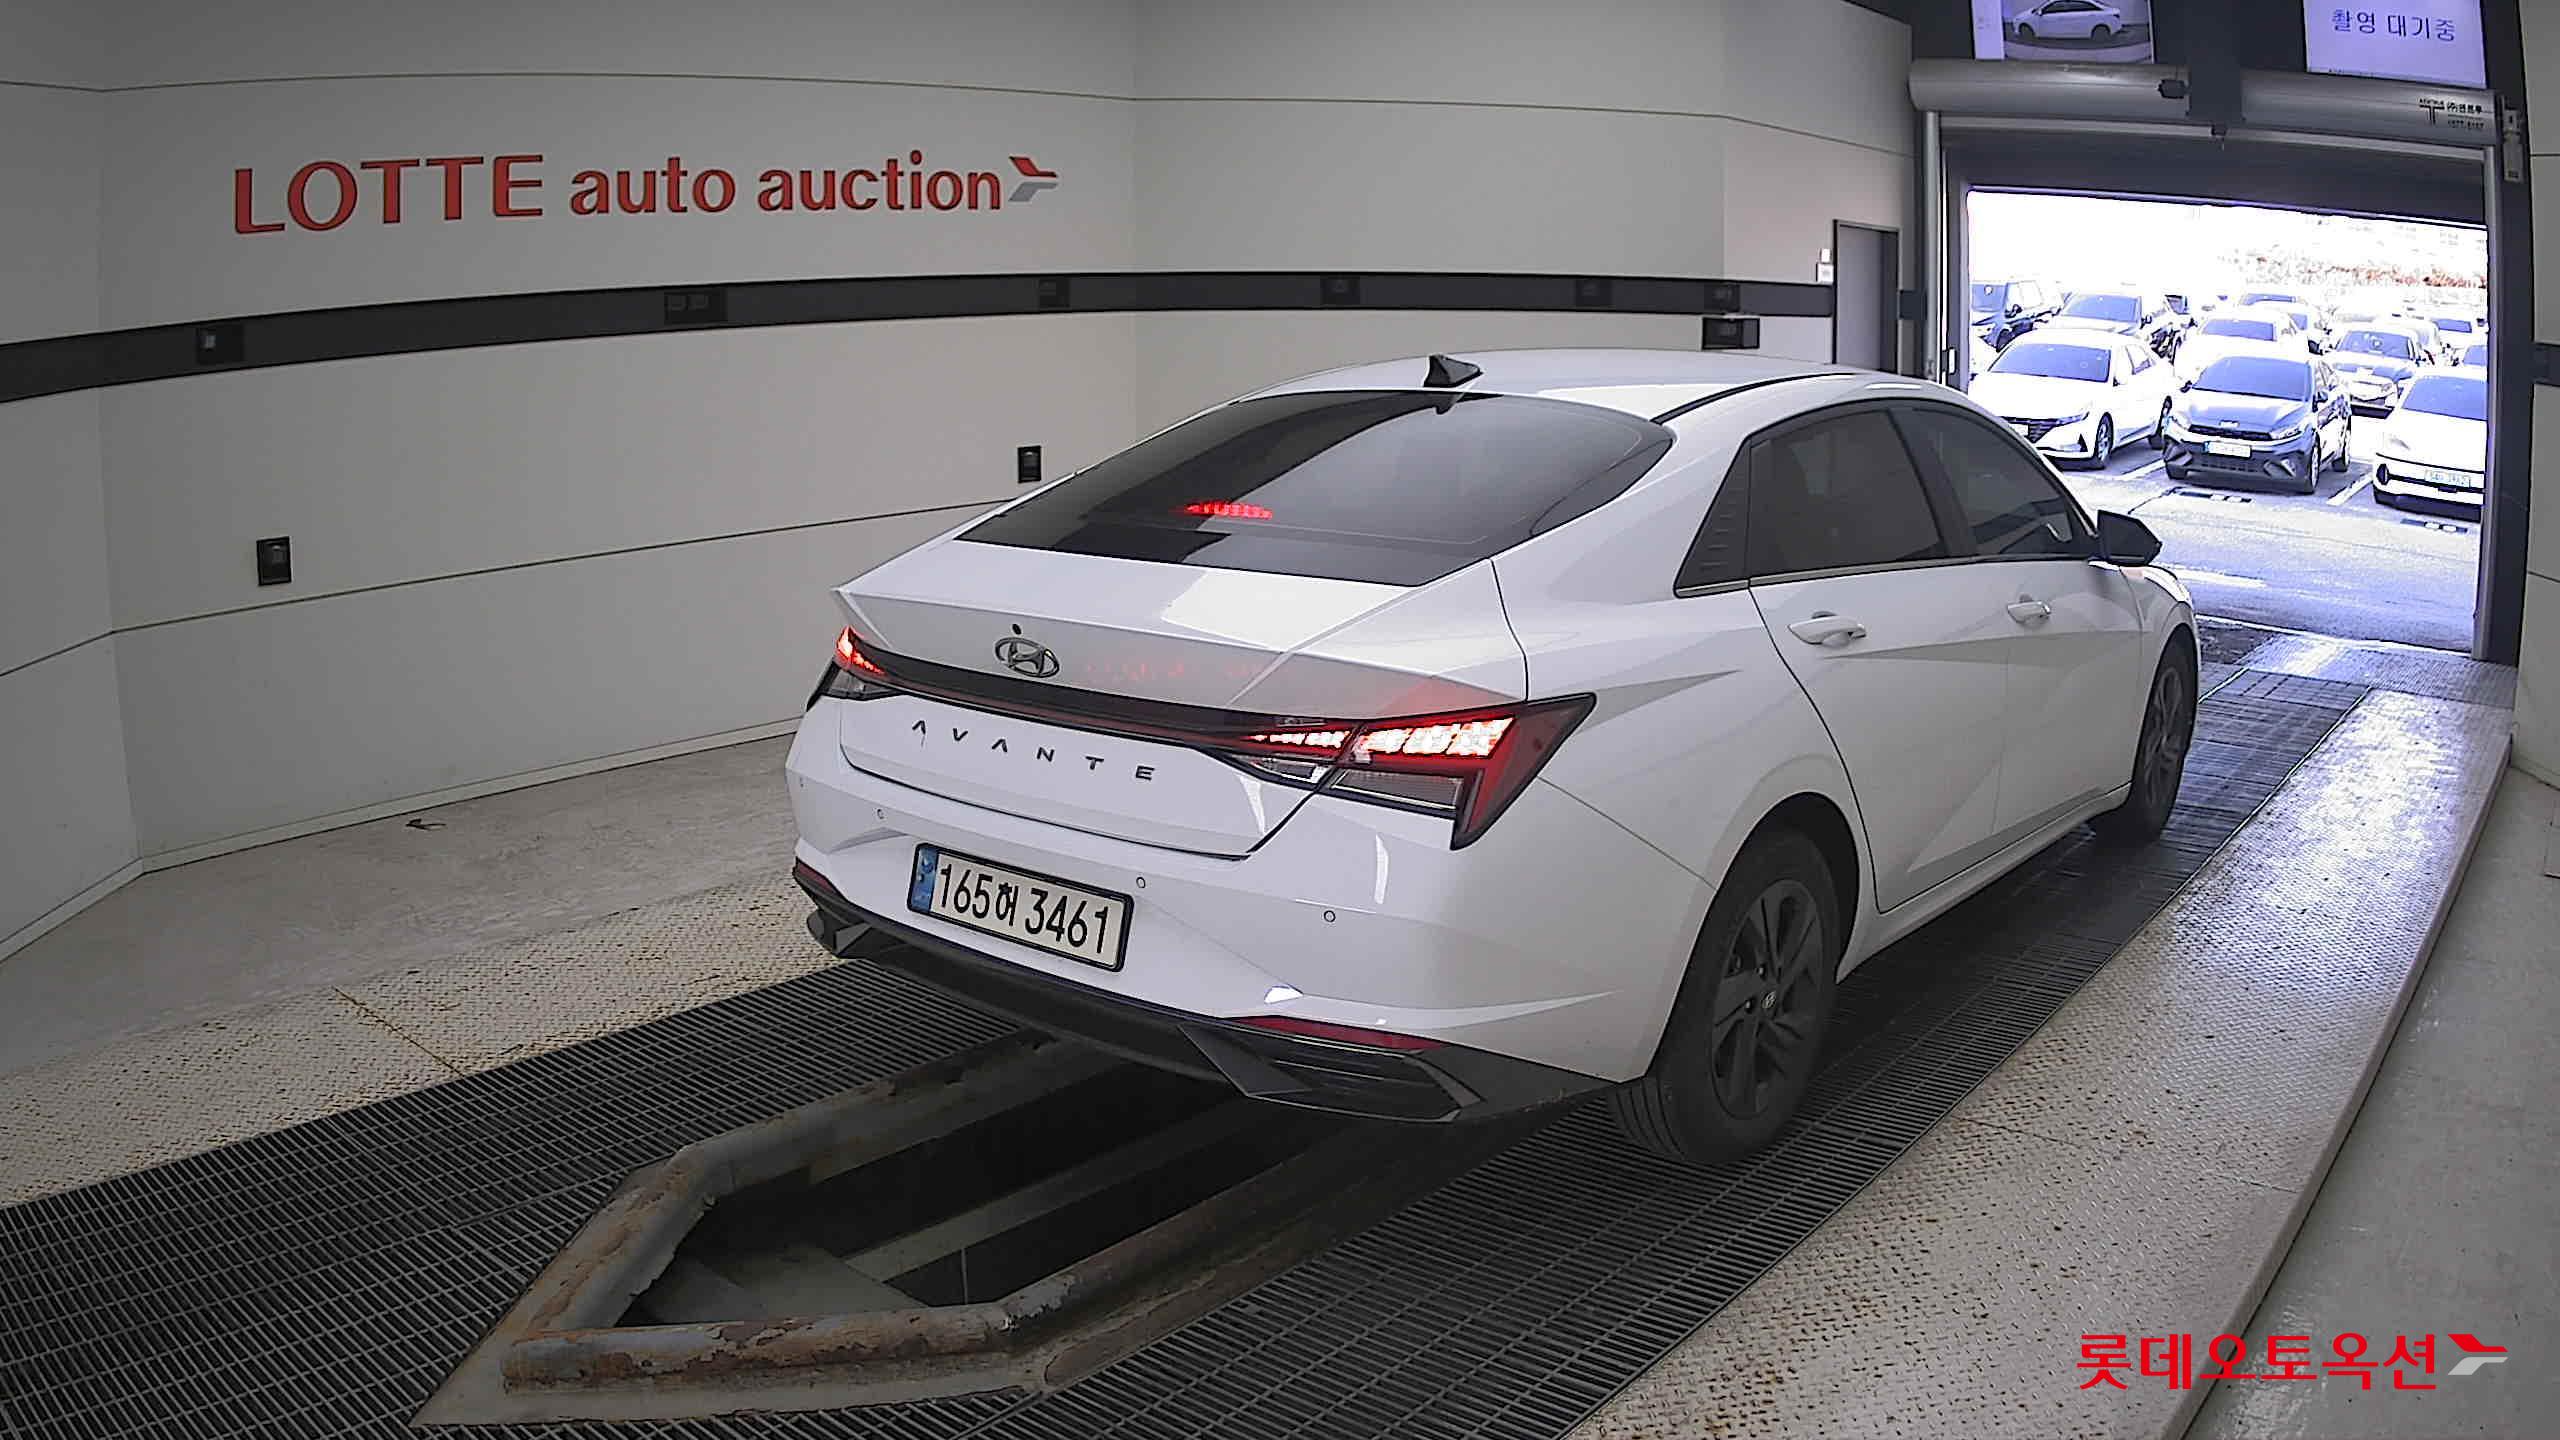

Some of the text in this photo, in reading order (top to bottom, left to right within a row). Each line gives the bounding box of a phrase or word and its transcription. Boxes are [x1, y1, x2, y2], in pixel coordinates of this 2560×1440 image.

[2331, 8, 2377, 35] 촬영
[234, 149, 1002, 235] LOTTE auto auction
[911, 719, 1155, 782] AVANTE
[1024, 886, 1110, 955] 3461
